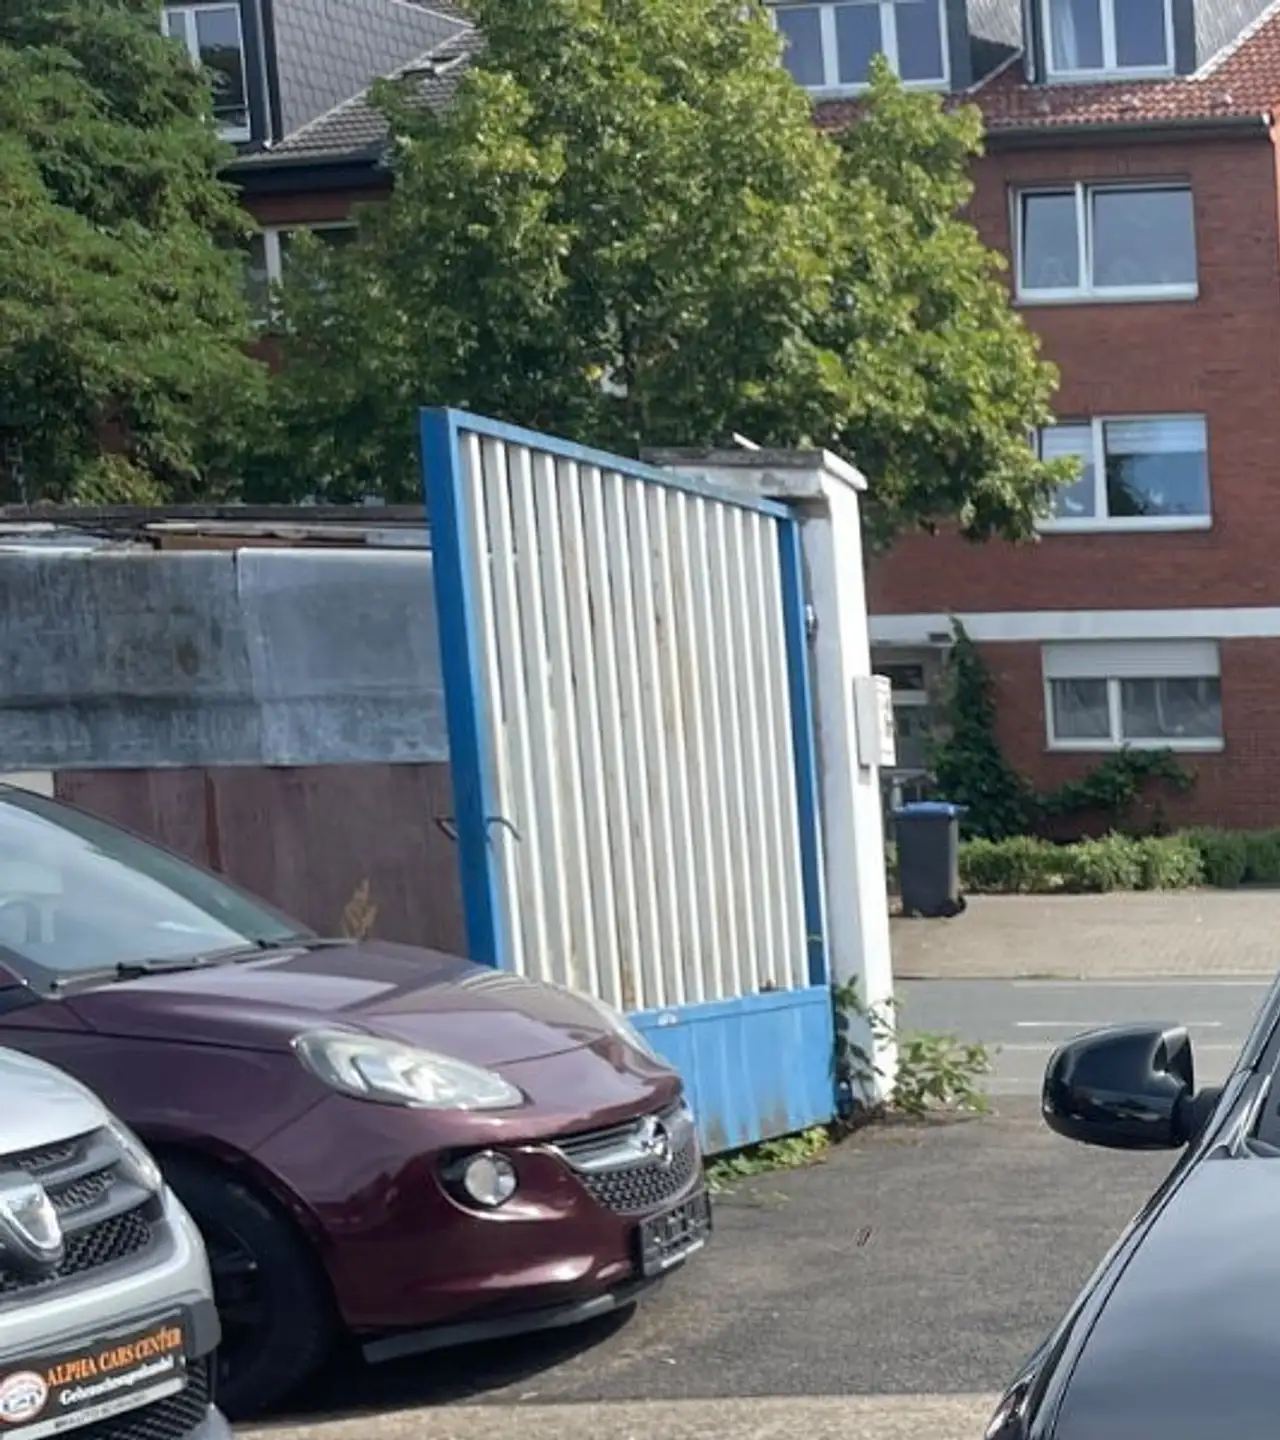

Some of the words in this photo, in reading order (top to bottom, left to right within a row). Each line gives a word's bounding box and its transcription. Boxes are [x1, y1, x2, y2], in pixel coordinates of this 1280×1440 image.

[46, 1356, 98, 1386] ALPHA
[98, 1344, 134, 1372] CARS
[134, 1326, 182, 1359] CENTER
